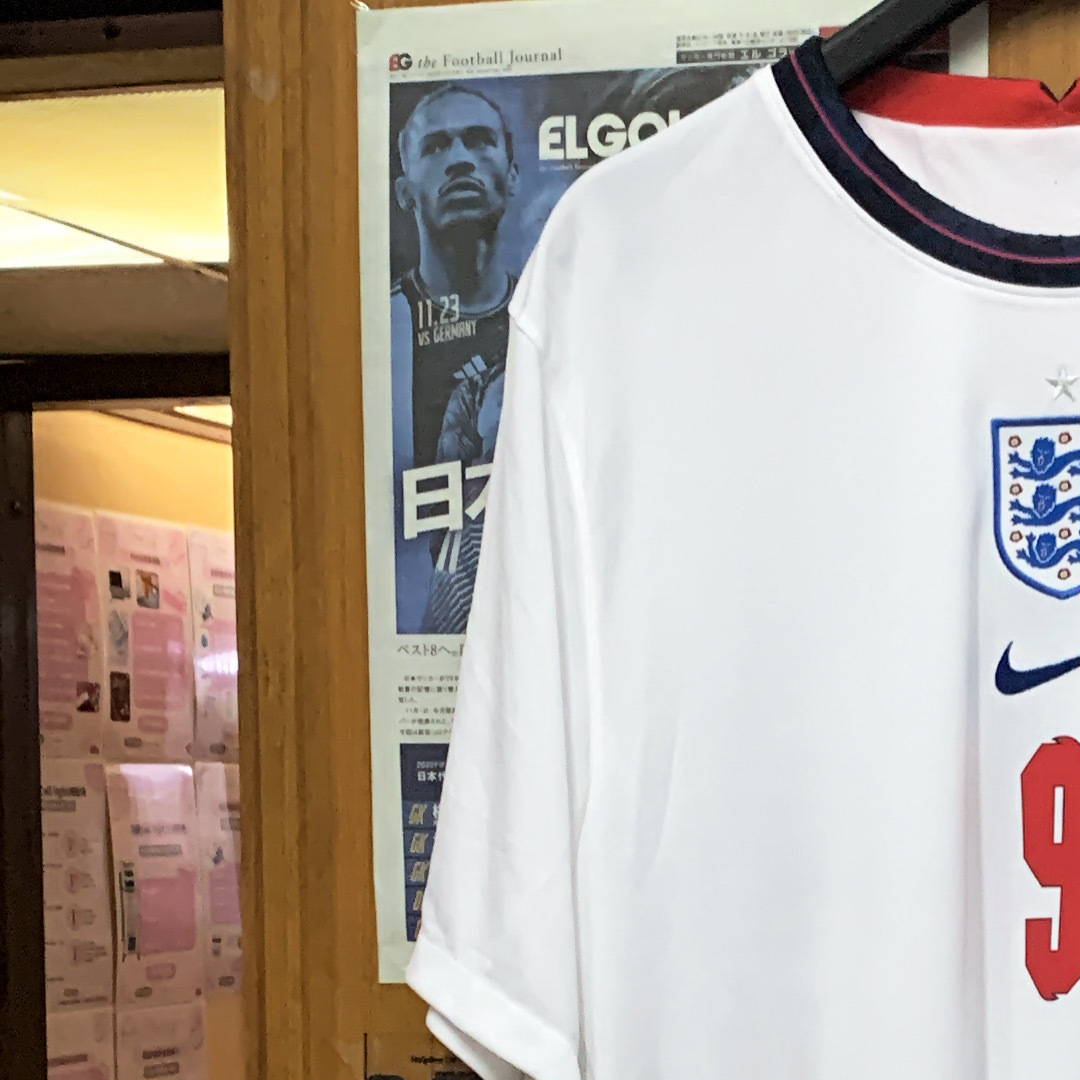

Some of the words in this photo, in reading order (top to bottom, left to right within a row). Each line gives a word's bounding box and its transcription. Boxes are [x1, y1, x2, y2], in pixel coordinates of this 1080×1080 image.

[443, 51, 503, 67] Football
[508, 48, 563, 66] Journal
[418, 293, 460, 329] 11.23
[418, 331, 430, 347] VS
[433, 320, 477, 343] GERMANY
